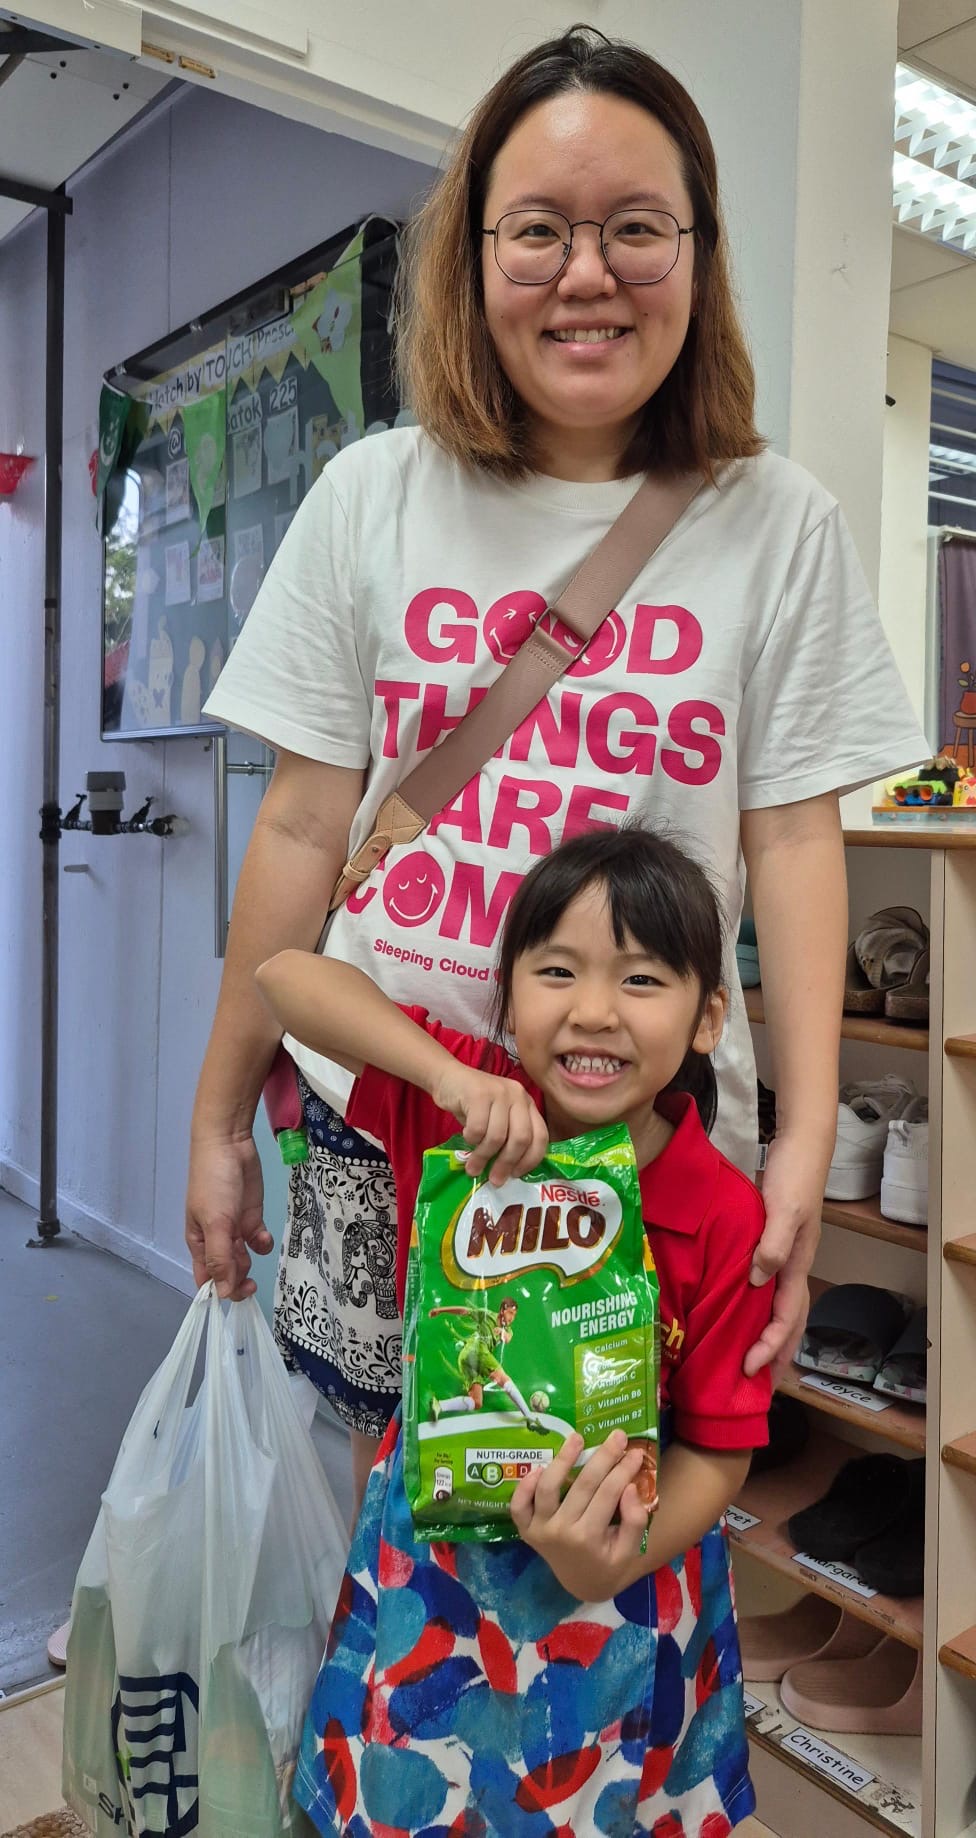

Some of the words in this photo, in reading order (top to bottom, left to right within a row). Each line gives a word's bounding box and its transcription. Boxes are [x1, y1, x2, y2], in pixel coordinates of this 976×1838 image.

[187, 366, 201, 393] by
[205, 336, 252, 381] TOUCH
[270, 381, 297, 412] 225
[404, 587, 703, 677] GOOD
[375, 680, 726, 786] THNGS
[374, 938, 434, 971] Sleeping
[439, 957, 490, 981] Cloud
[467, 1204, 607, 1259] MILO
[551, 1291, 638, 1328] NOURISHING
[580, 1308, 636, 1338] ENERGY
[595, 1339, 628, 1353] Calcium
[598, 1394, 630, 1409] Vitamin
[821, 1380, 872, 1403] Joyce
[598, 1414, 630, 1429] Vitamin
[632, 1409, 642, 1418] B2
[476, 1450, 543, 1460] NUTRI-GRADE
[470, 1466, 479, 1477] A
[486, 1467, 498, 1481] B
[505, 1466, 513, 1476] C
[520, 1466, 528, 1476] D
[790, 1733, 865, 1786] Christine
